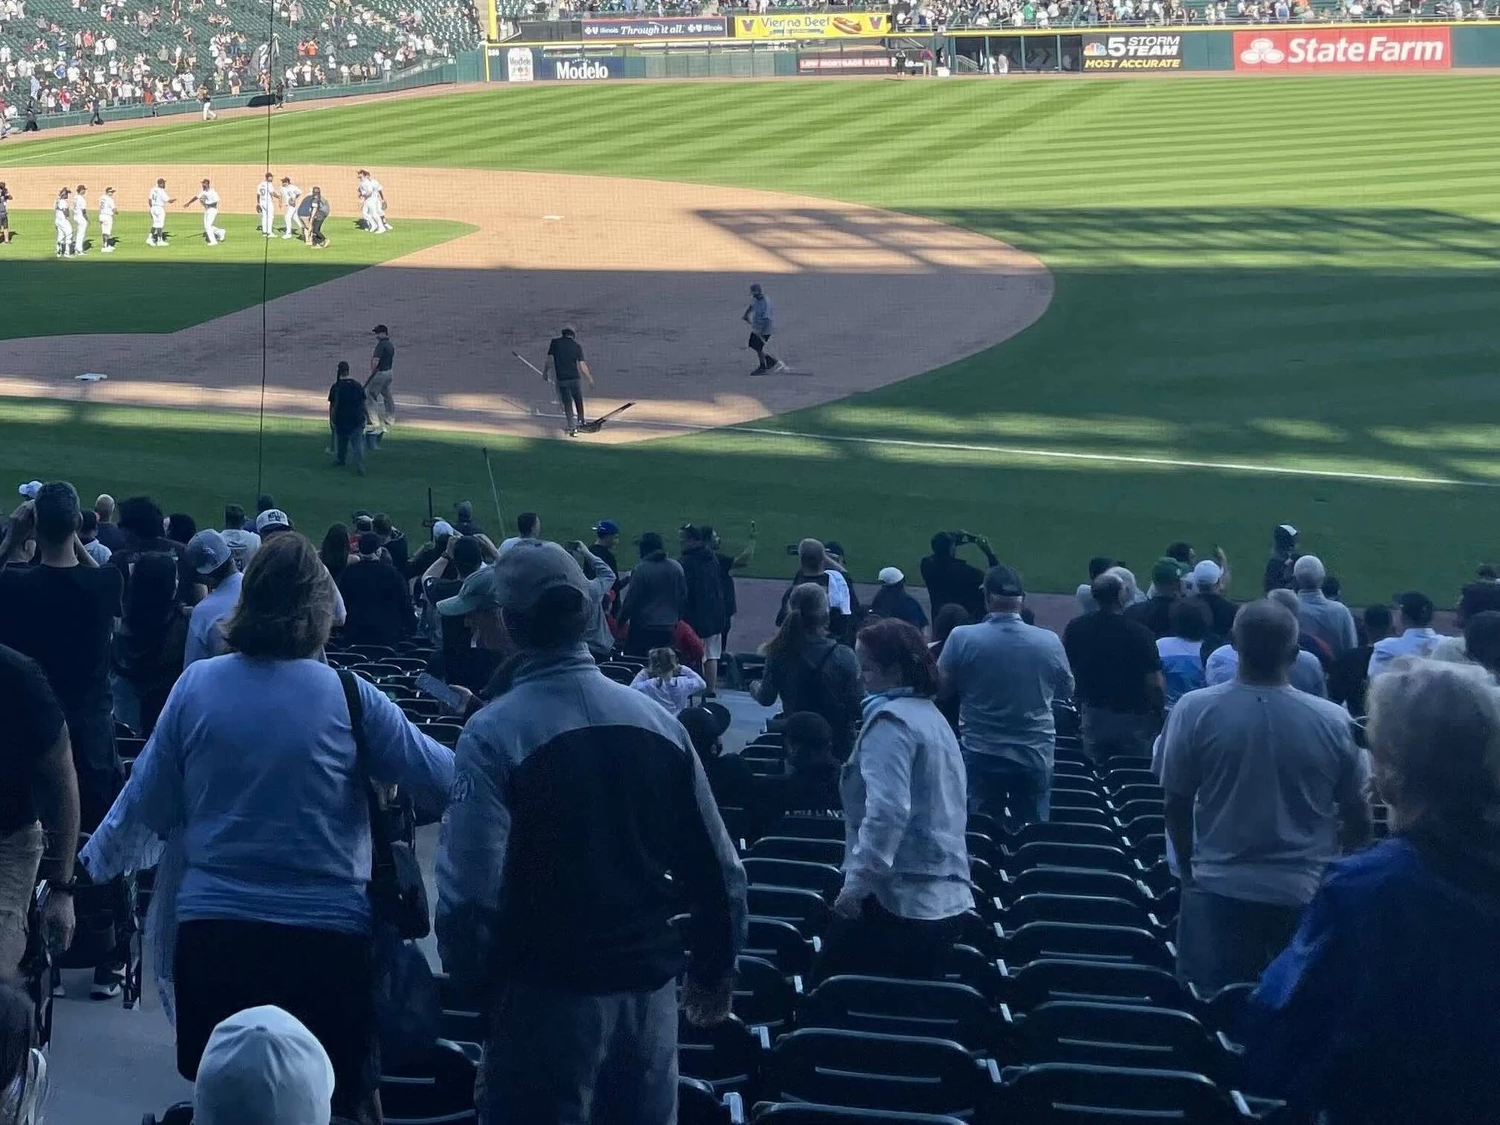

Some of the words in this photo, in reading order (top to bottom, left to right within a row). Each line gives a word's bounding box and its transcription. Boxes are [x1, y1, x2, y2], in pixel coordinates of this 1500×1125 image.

[805, 16, 831, 26] Beef
[620, 26, 660, 36] Through
[661, 25, 668, 33] it
[670, 24, 684, 33] all.
[1107, 37, 1127, 58] 5
[1128, 36, 1180, 46] STORM
[1128, 46, 1179, 56] TEAM
[1287, 36, 1364, 63] State
[1368, 36, 1444, 63] Farm
[556, 60, 609, 80] Modelo
[1084, 59, 1118, 69] MOST
[1120, 59, 1180, 68] ACCURATE
